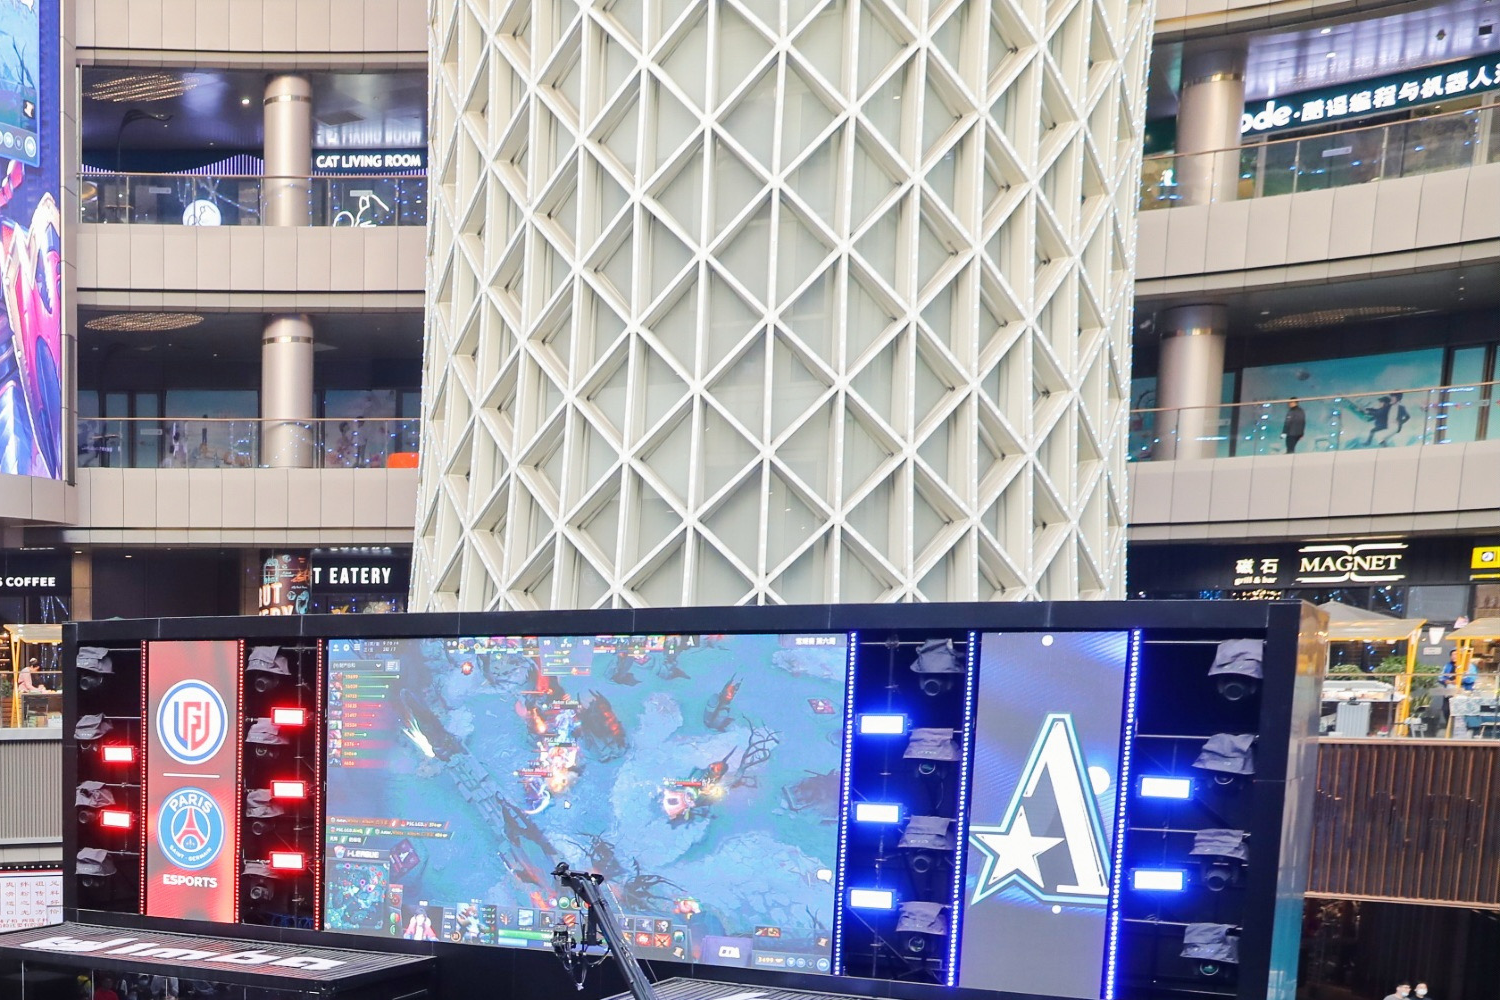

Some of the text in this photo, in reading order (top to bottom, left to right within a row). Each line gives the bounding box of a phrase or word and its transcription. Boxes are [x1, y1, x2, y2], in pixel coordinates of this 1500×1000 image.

[316, 154, 422, 169] CAT LIVING ROOM
[1234, 558, 1279, 575] 磁石
[1299, 553, 1402, 574] MAGNET
[5, 576, 57, 588] COFFEE
[329, 567, 392, 584] EATERY
[168, 793, 213, 813] PARIS
[169, 844, 213, 862] SAINT GERMAIN
[163, 873, 218, 888] ESPORTS
